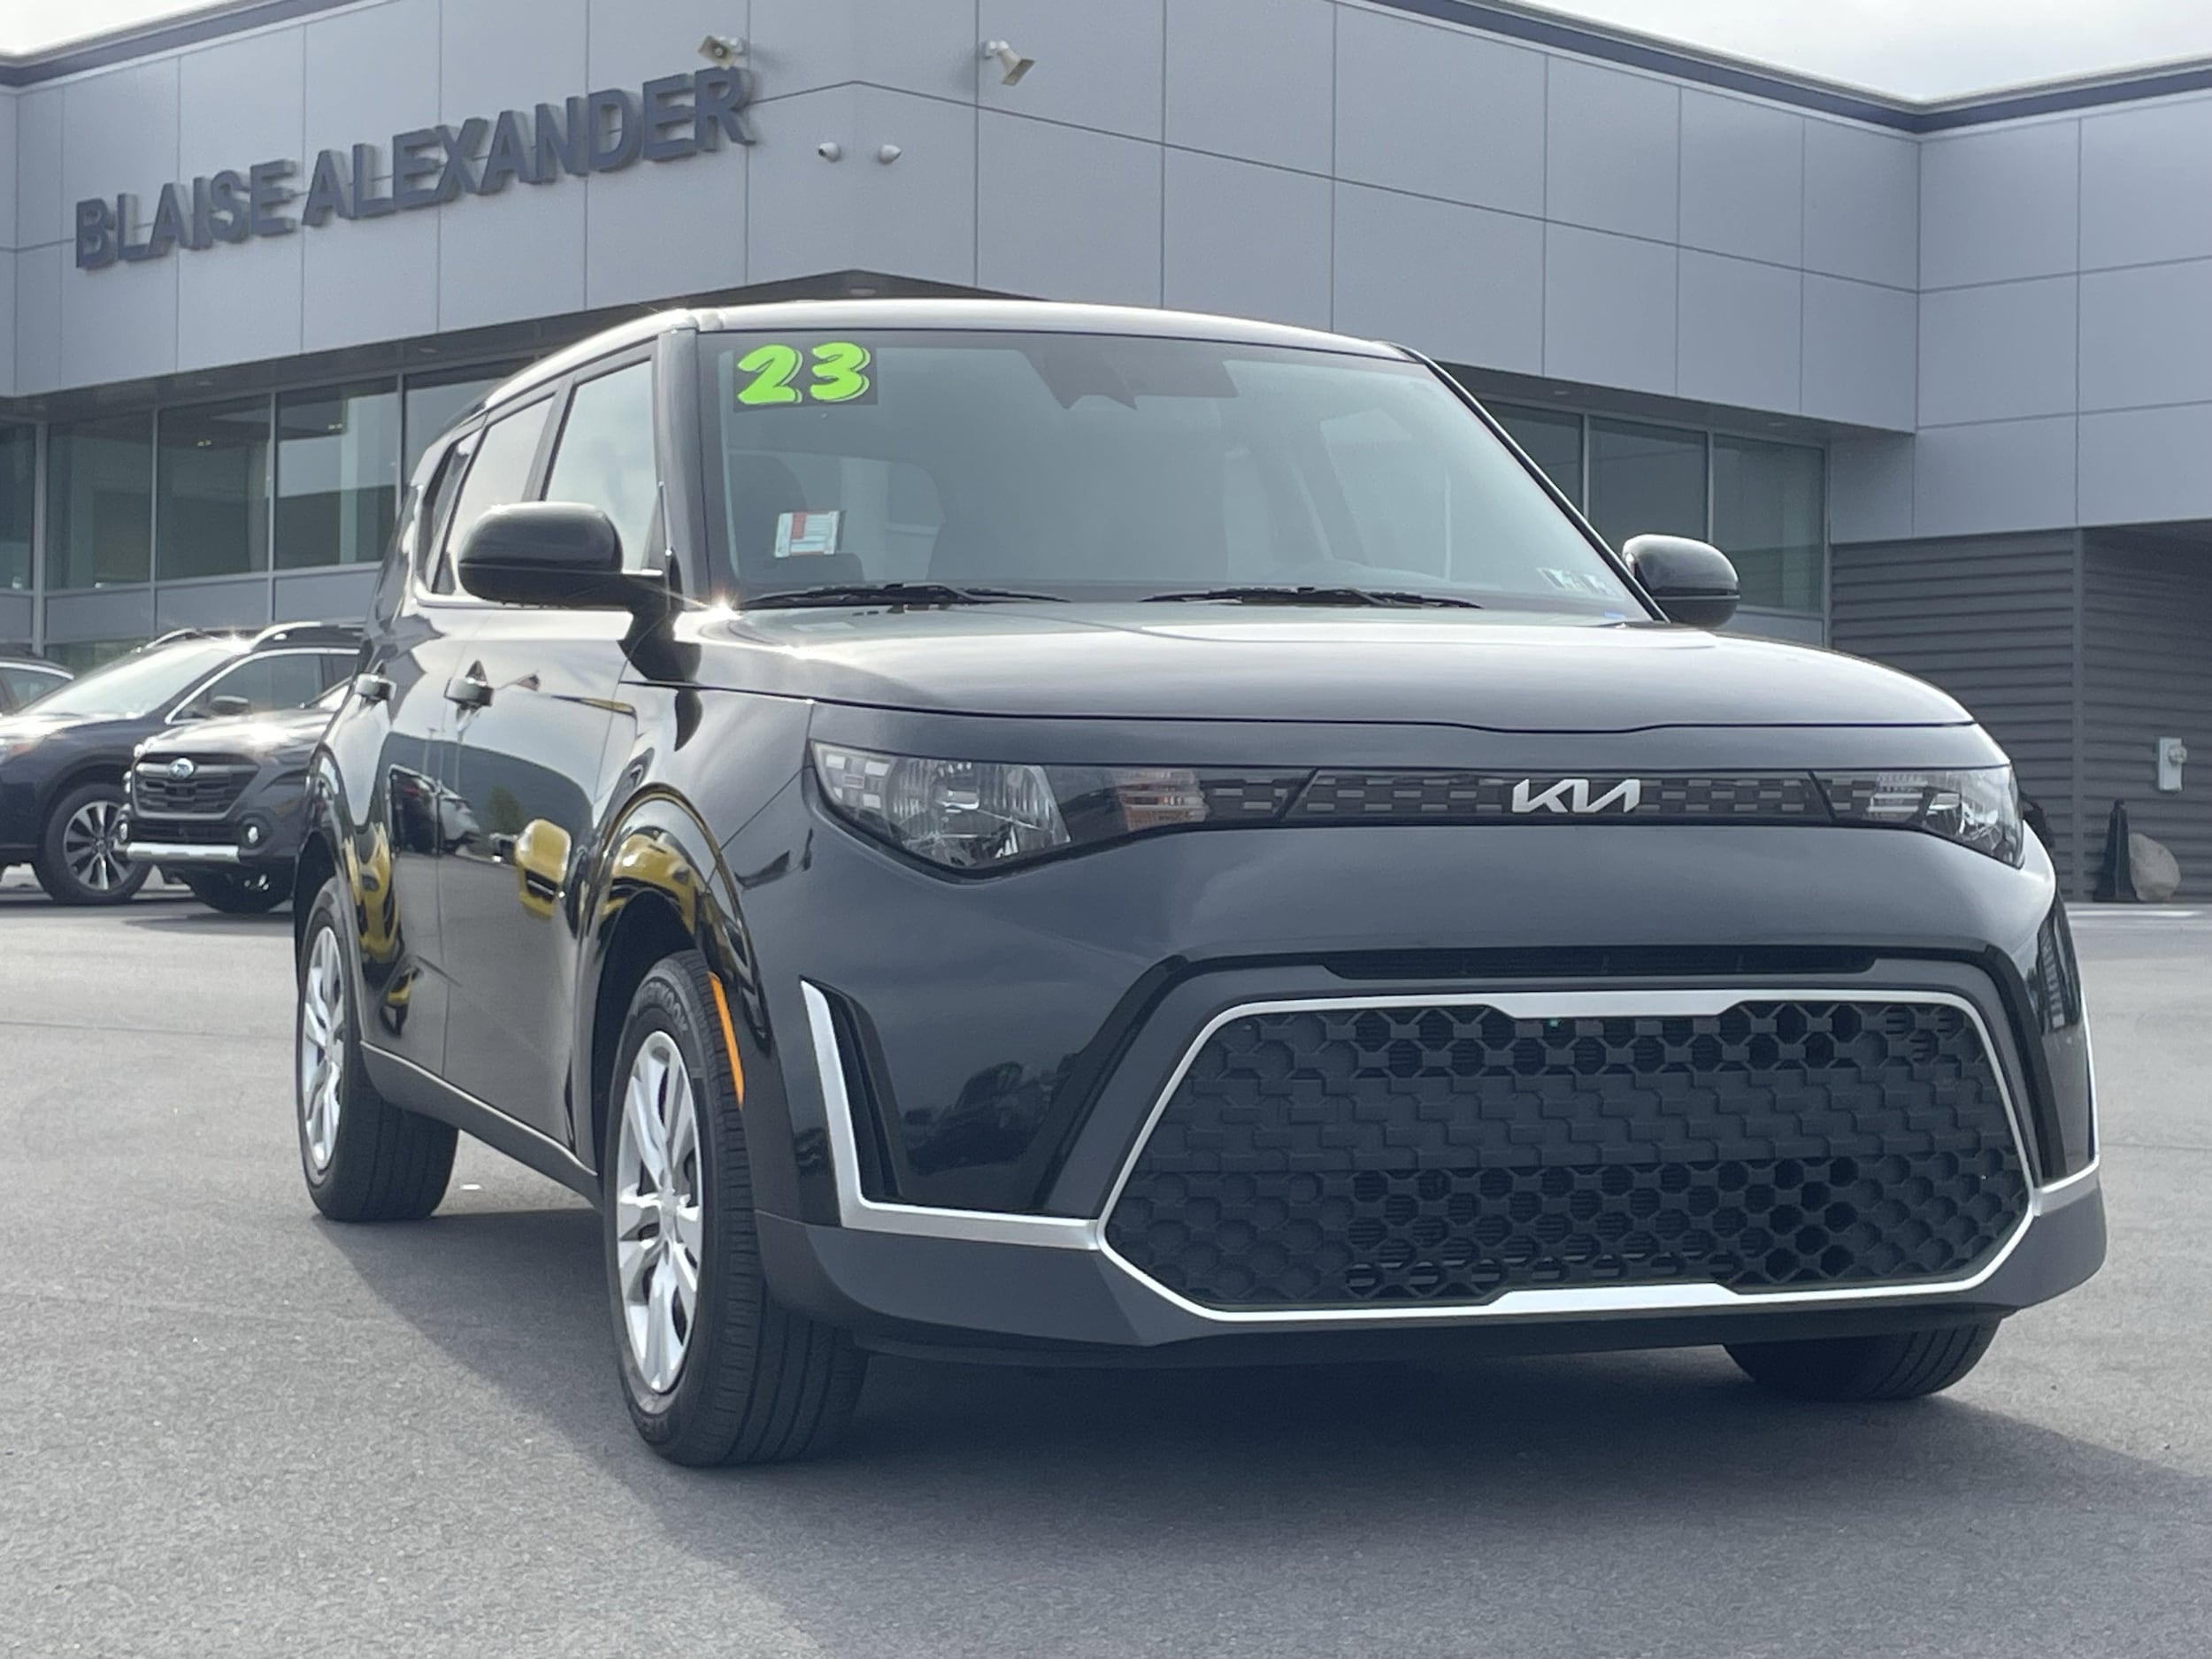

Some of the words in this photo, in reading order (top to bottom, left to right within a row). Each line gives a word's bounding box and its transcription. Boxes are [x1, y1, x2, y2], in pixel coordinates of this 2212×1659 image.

[76, 159, 296, 269] BLAISE
[302, 66, 757, 227] ALEXANDER
[737, 342, 871, 405] 23
[1512, 779, 1641, 813] KIA
